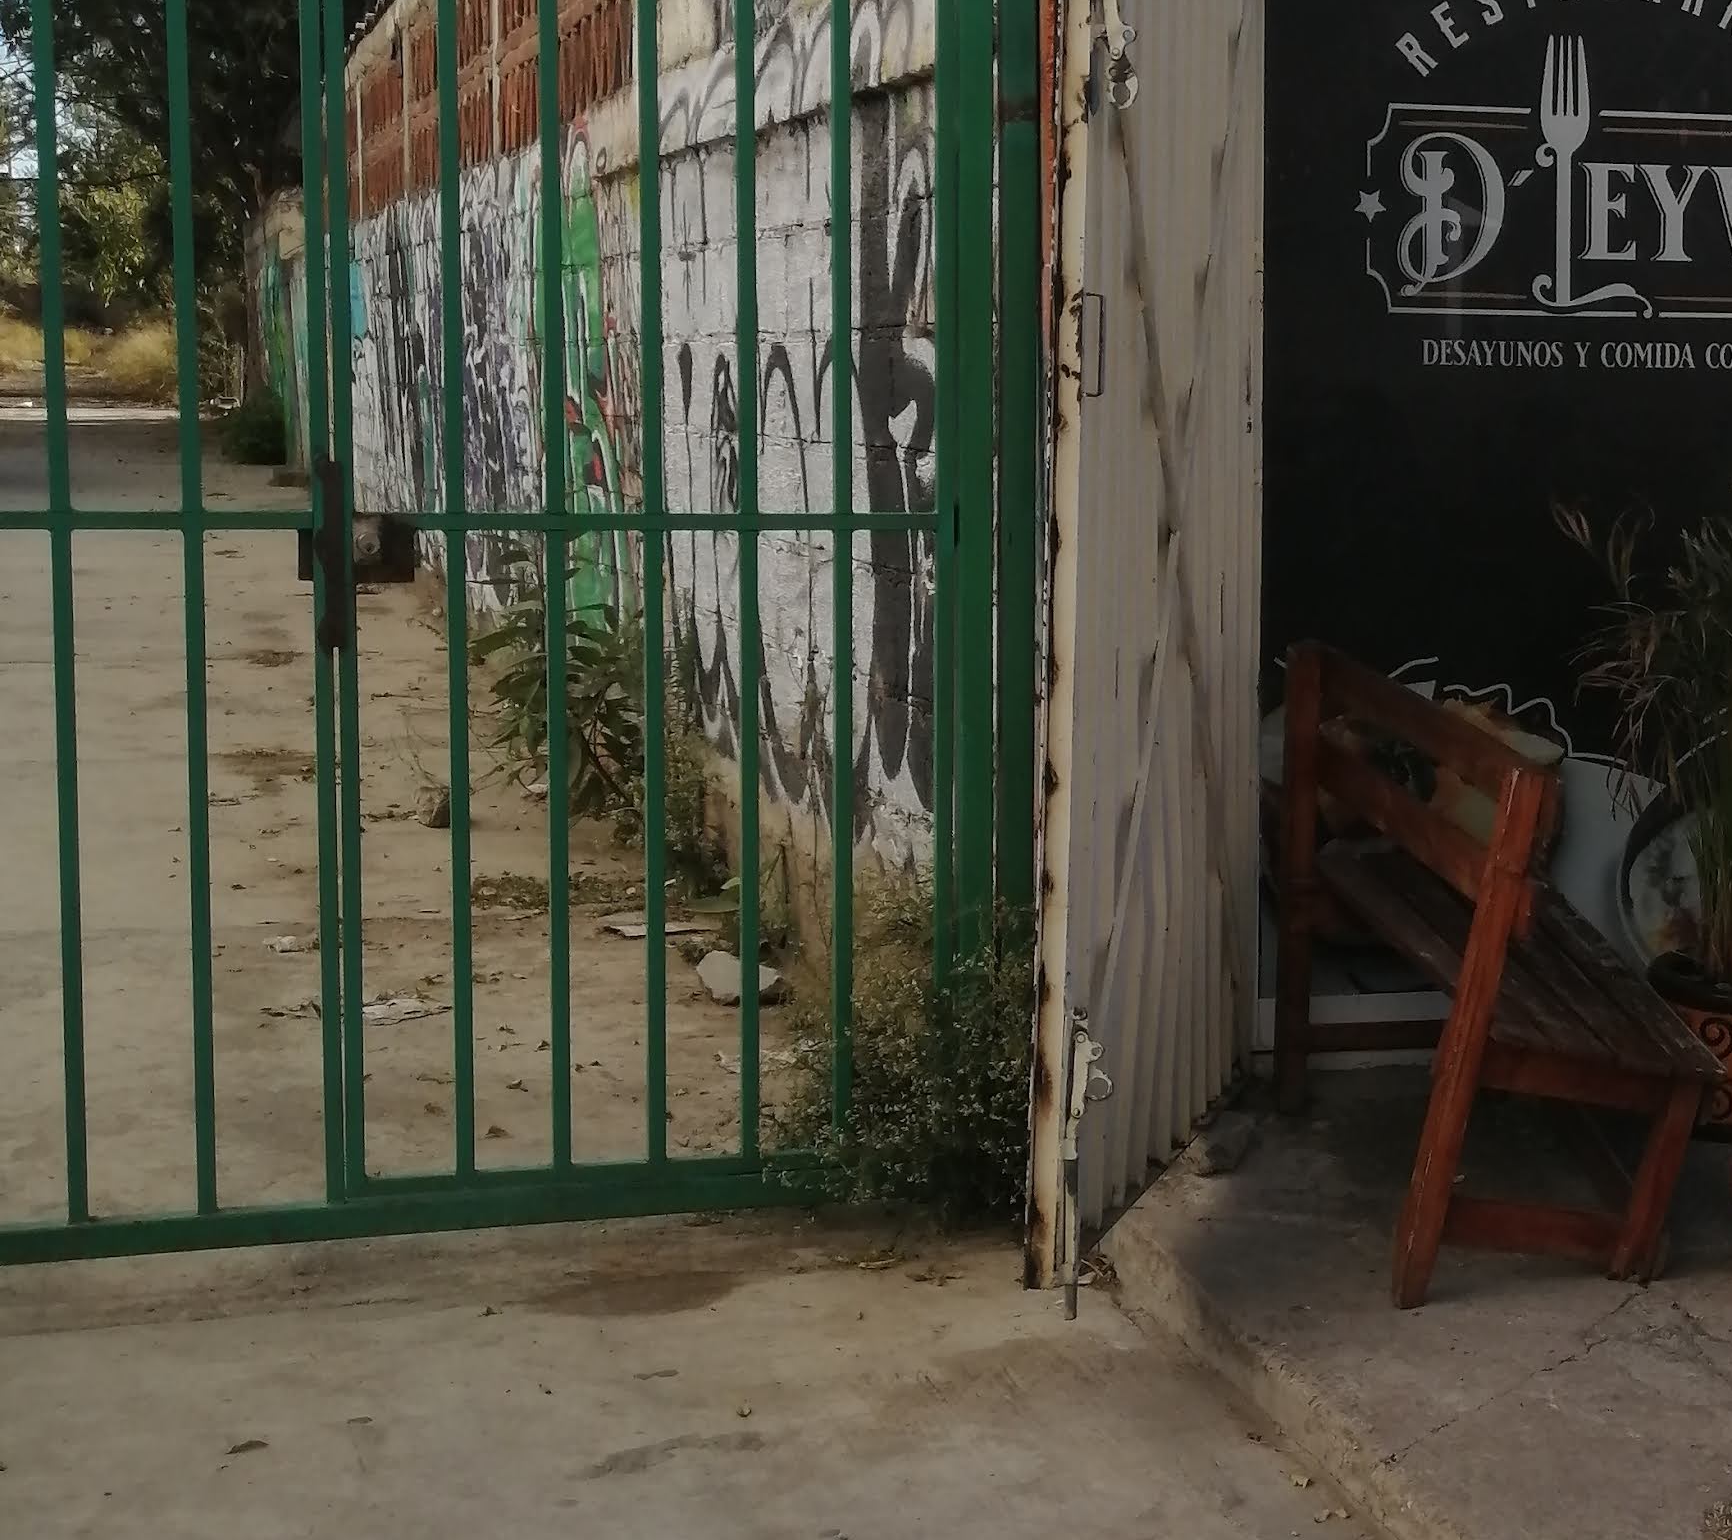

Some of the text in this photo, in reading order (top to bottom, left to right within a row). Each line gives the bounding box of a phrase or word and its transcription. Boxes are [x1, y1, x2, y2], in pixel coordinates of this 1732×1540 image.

[1422, 340, 1564, 368] DESAYUNOS
[1575, 342, 1591, 368] Y
[1601, 342, 1696, 369] COMIDA
